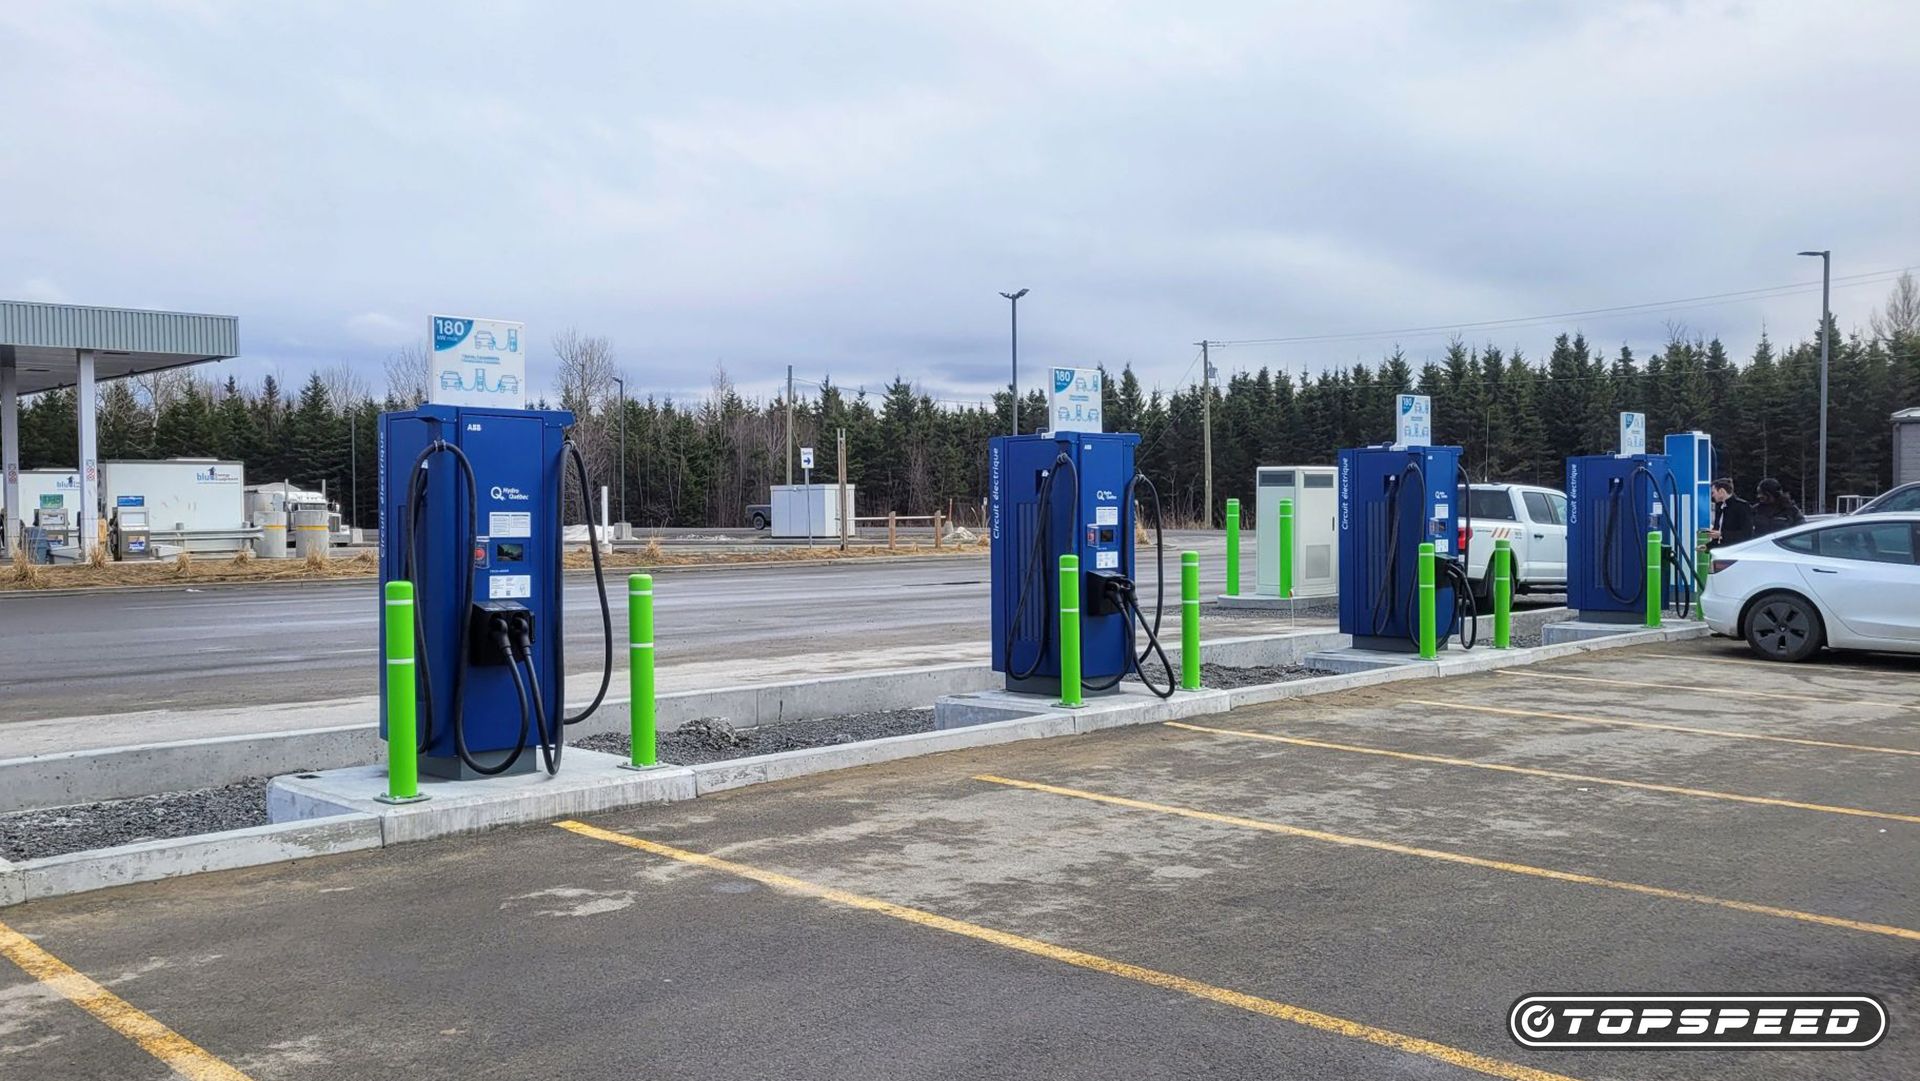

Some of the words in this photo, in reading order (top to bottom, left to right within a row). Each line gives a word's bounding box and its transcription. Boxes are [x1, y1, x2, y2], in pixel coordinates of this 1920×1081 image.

[437, 319, 464, 336] 180
[1055, 370, 1071, 381] 180
[992, 447, 1000, 501] électrique
[1341, 502, 1349, 530] Circuit
